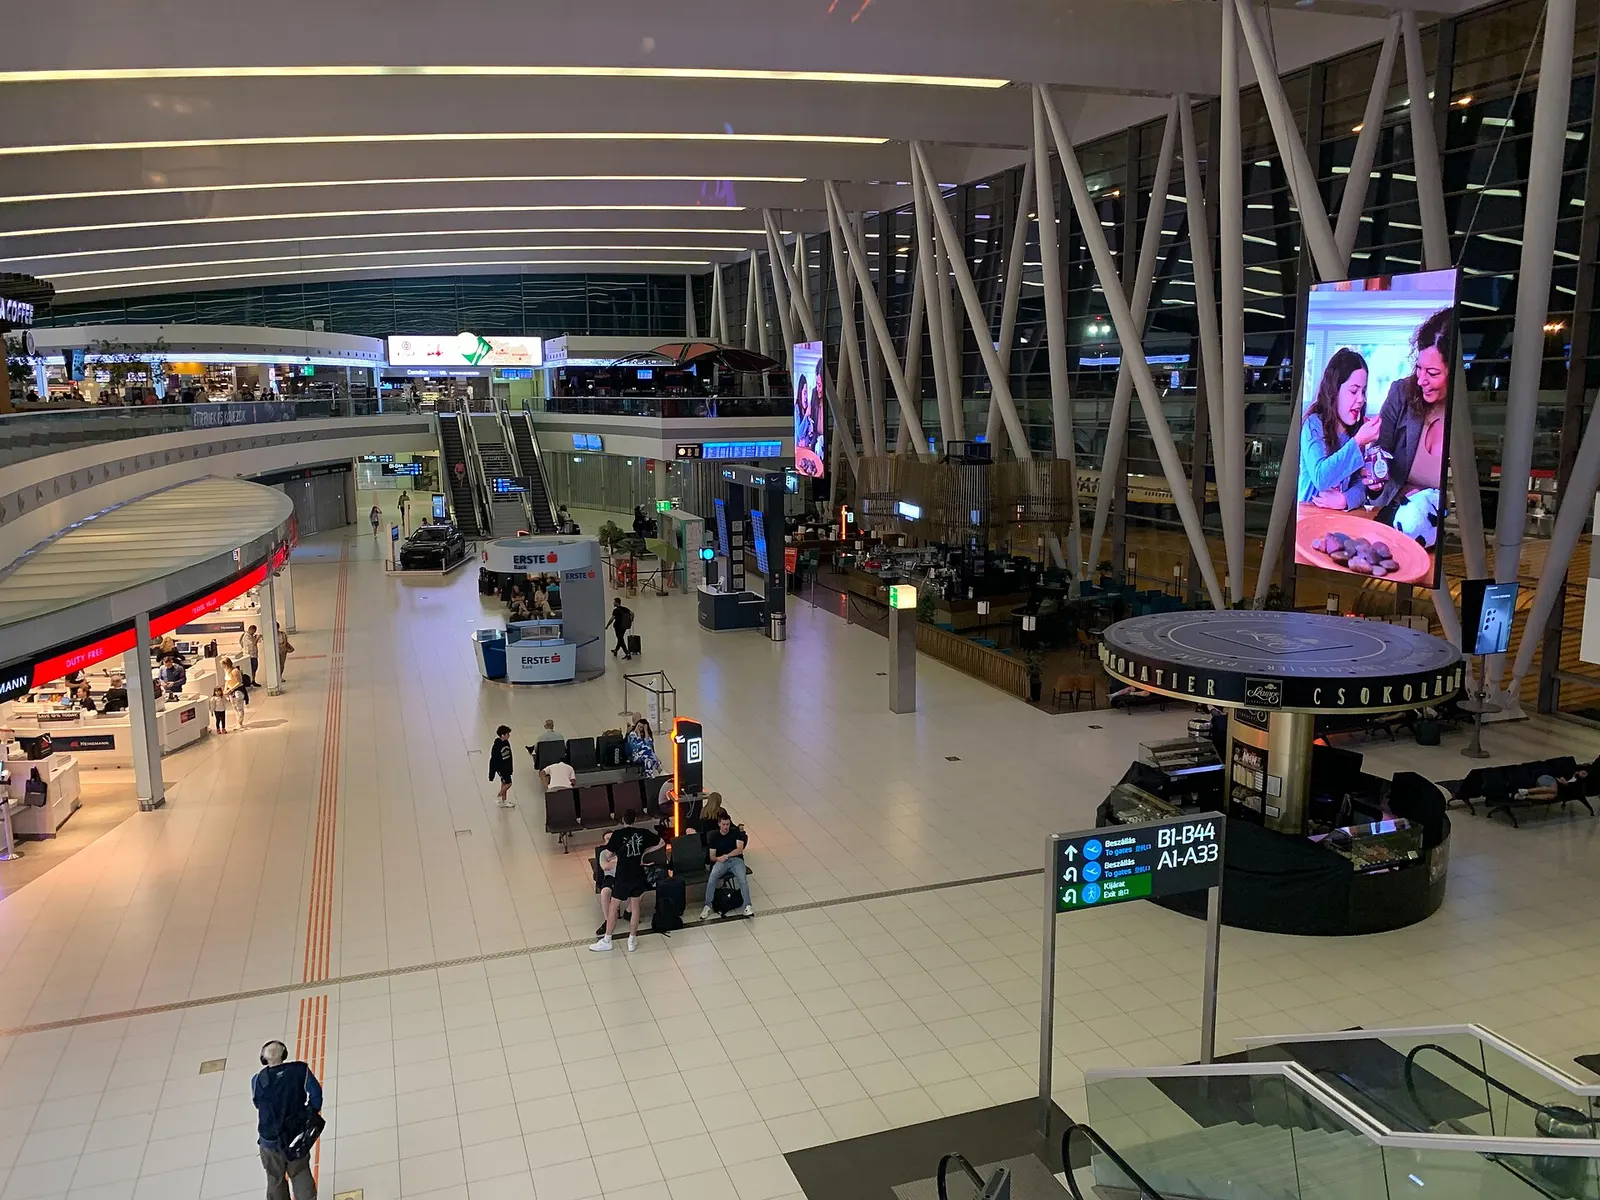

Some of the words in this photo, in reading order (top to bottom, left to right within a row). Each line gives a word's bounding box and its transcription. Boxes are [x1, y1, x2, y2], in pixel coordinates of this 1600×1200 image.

[7, 299, 34, 325] COFFEE
[513, 554, 546, 564] ERSTE
[66, 654, 85, 668] DUTY
[87, 647, 104, 660] FREE
[521, 656, 550, 665] ERSTE
[1157, 822, 1216, 848] B1-B44
[1105, 848, 1113, 856] To
[1114, 847, 1132, 856] gates
[1157, 843, 1219, 870] A1-A33
[1104, 869, 1112, 878] To
[1113, 868, 1132, 877] gates
[1103, 890, 1116, 899] Exit
